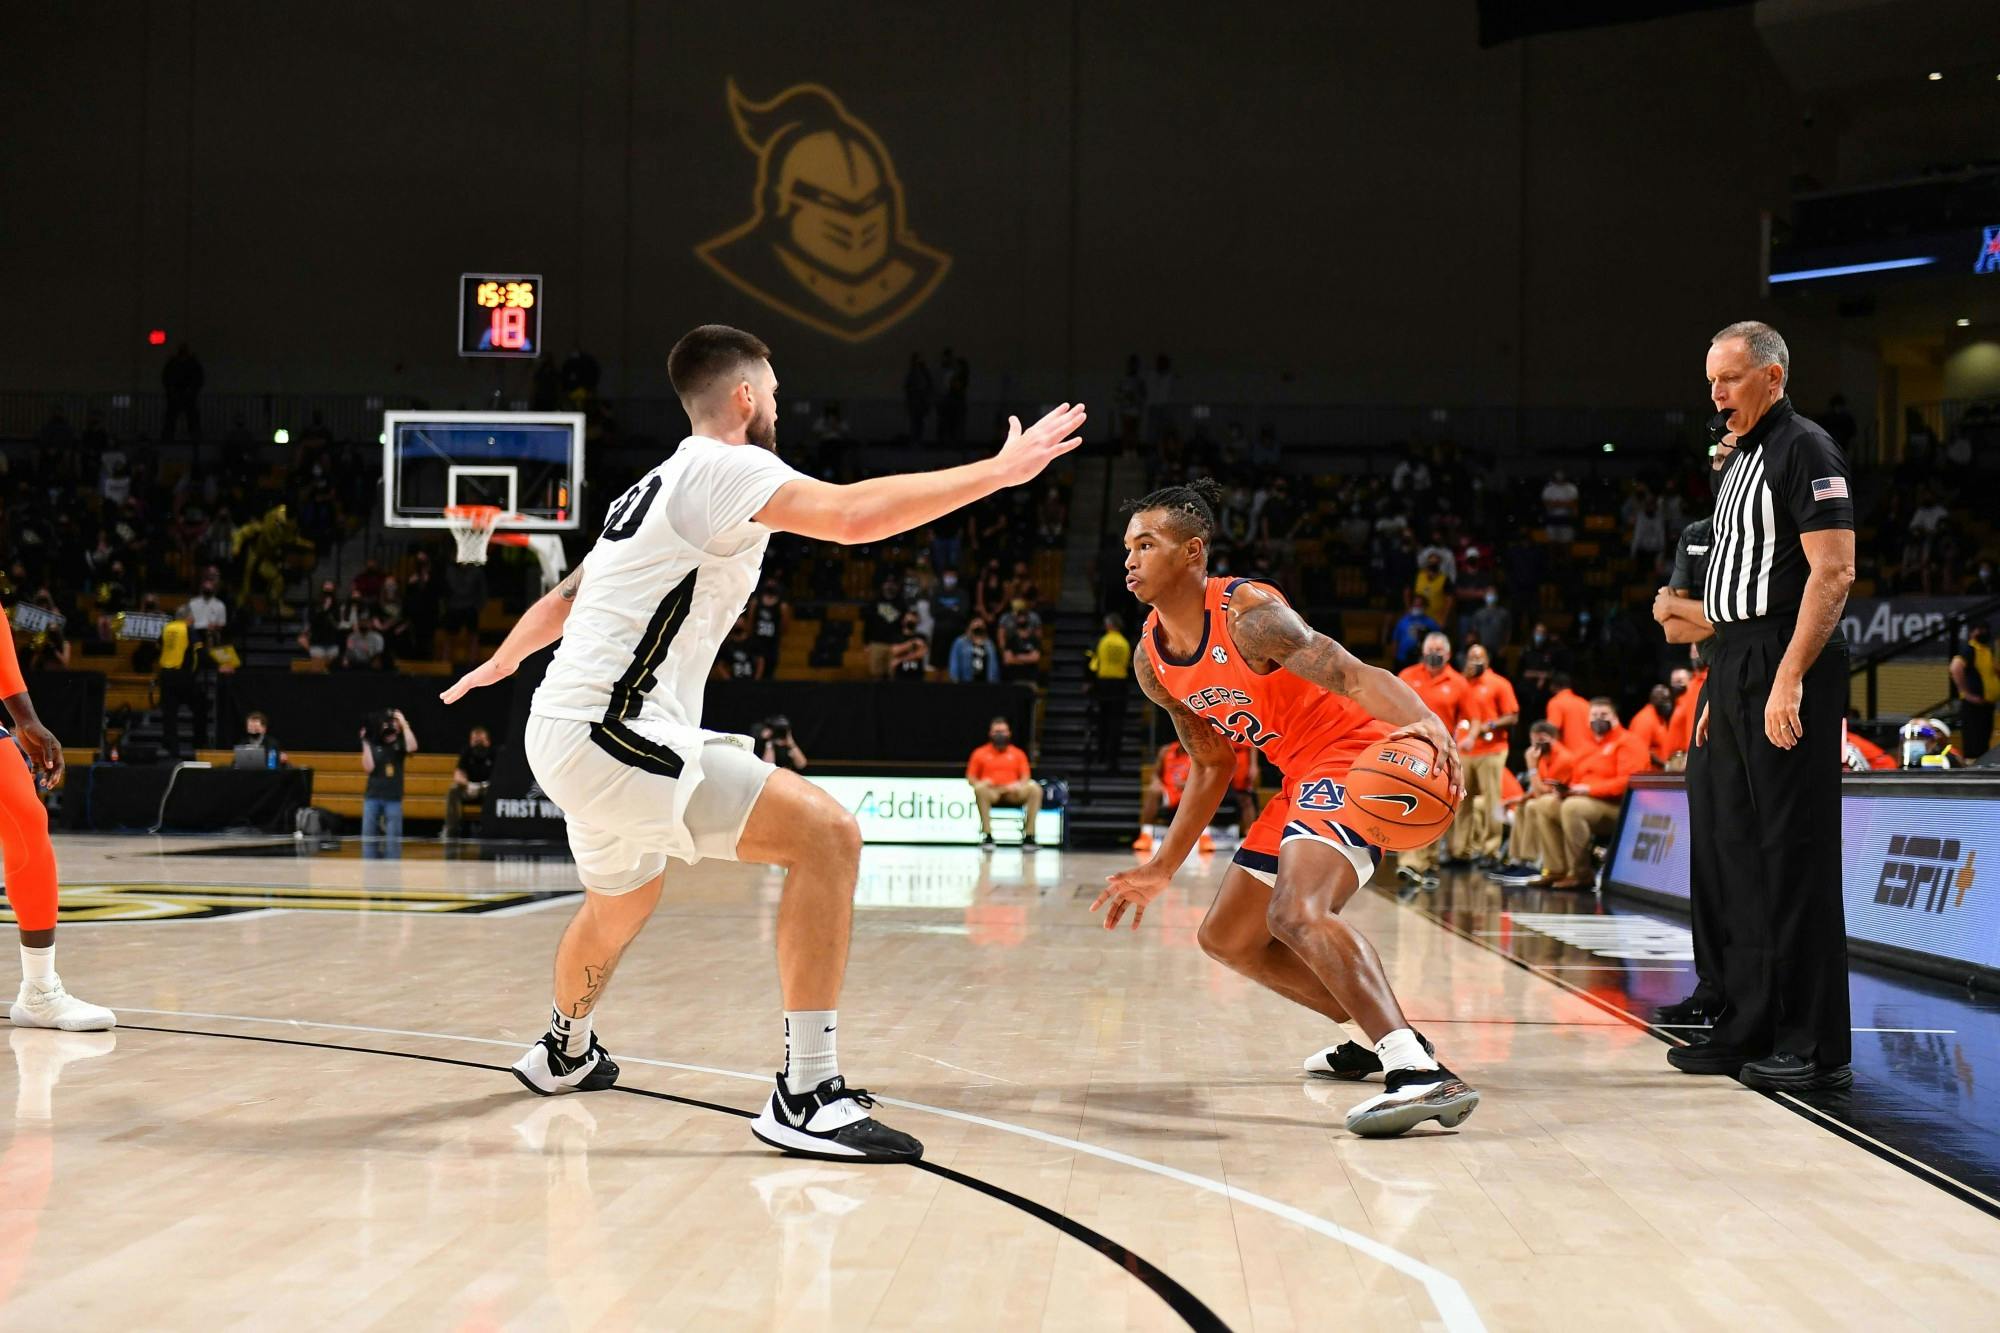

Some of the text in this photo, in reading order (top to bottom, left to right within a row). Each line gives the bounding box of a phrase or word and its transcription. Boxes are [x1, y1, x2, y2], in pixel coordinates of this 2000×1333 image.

[478, 282, 533, 308] 15:36
[491, 307, 525, 348] 18
[1181, 686, 1254, 713] GERS
[496, 799, 537, 818] FIRST
[1874, 834, 1976, 914] ESPN+
